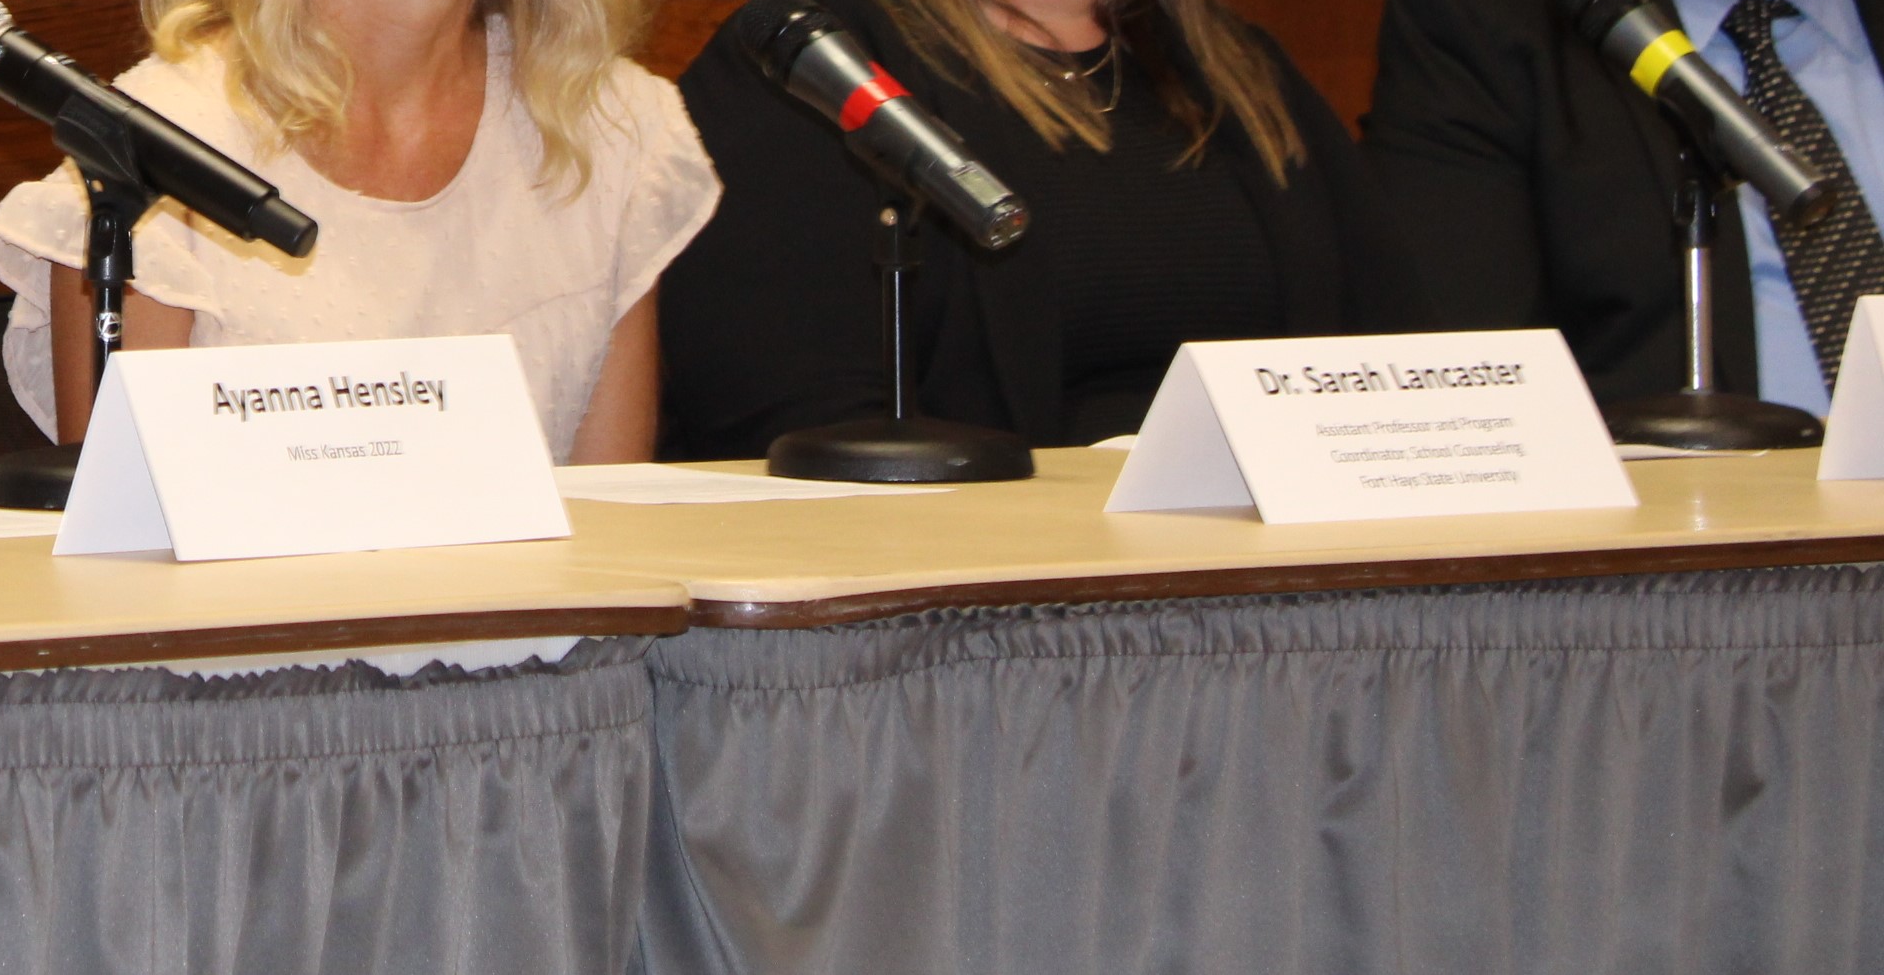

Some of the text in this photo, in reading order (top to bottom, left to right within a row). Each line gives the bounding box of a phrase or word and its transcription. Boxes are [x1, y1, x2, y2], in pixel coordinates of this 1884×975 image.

[1254, 361, 1526, 396] Dr. Sarah Lancaster
[212, 370, 447, 423] Ayanna Hensley
[1316, 416, 1513, 437] Assistant Professor and Program
[286, 439, 403, 461] Miss Kansas 2022
[1409, 444, 1453, 460] School
[1358, 469, 1517, 490] Fort Hays State University
